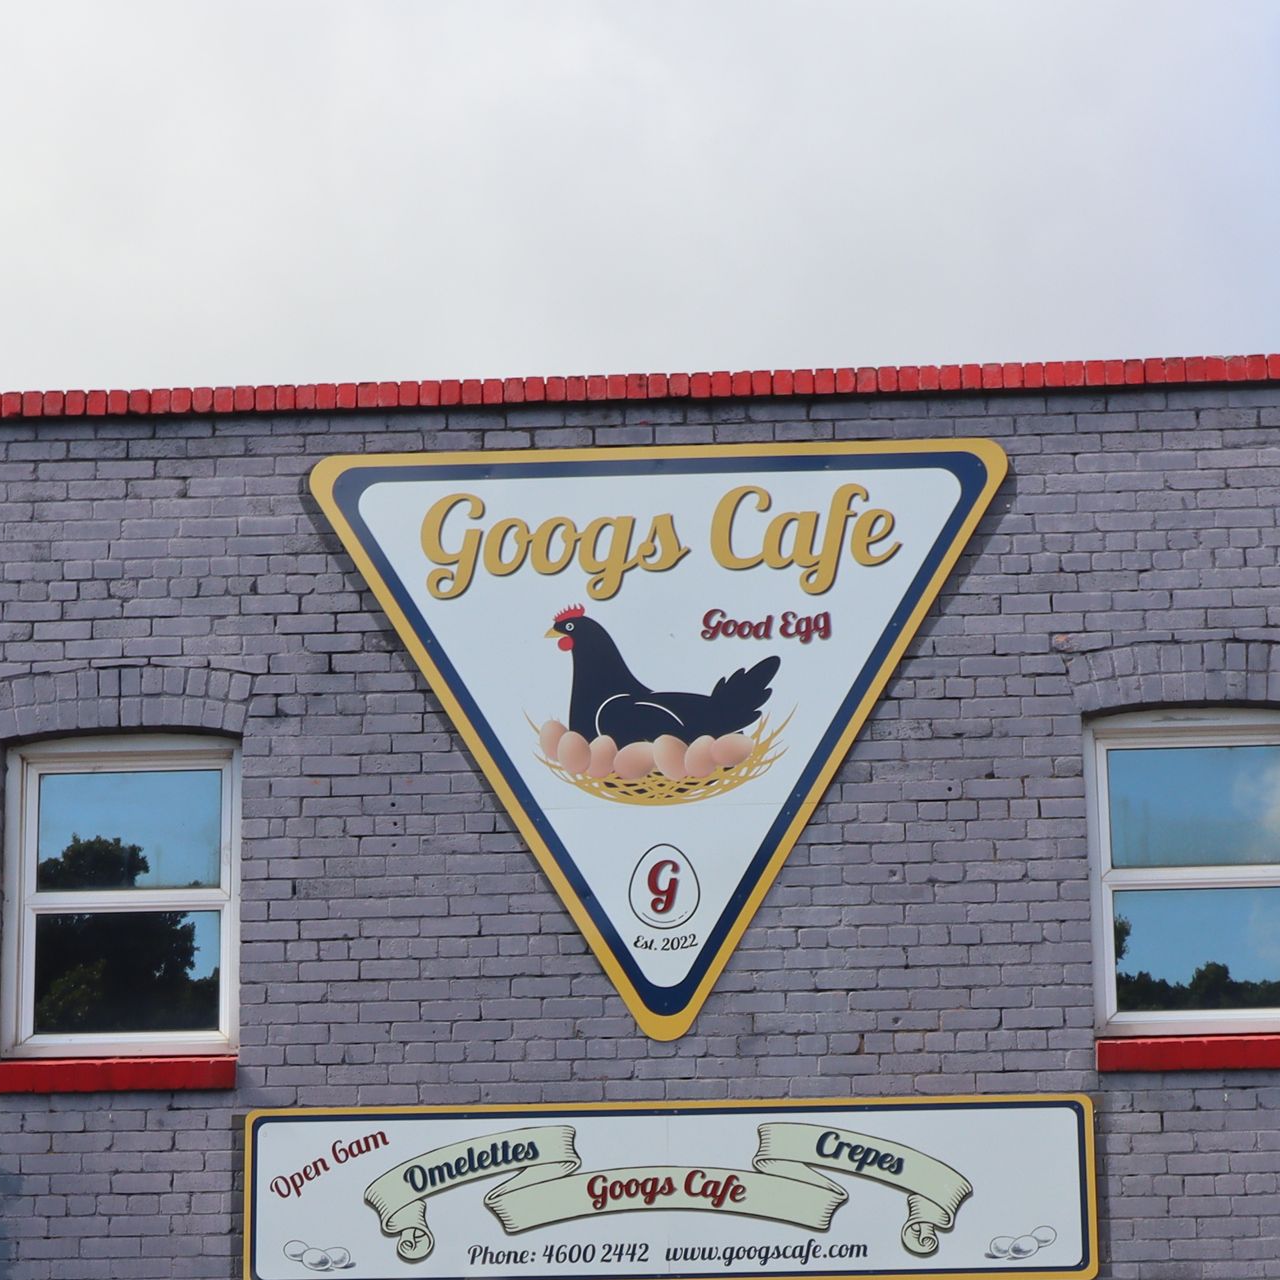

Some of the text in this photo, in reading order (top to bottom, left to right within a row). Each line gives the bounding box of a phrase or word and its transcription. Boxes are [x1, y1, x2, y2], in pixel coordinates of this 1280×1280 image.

[420, 484, 902, 600] Googs Cafe
[701, 608, 832, 644] Good Egg
[647, 859, 680, 914] G
[634, 934, 699, 951] Est. 2022
[270, 1130, 390, 1199] Open 6am
[403, 1140, 540, 1193] Omelettes
[816, 1131, 905, 1175] Crepes
[587, 1170, 747, 1210] Googs Cafe
[467, 1239, 868, 1267] Phone: 4600 2442 www.googscafe.com
